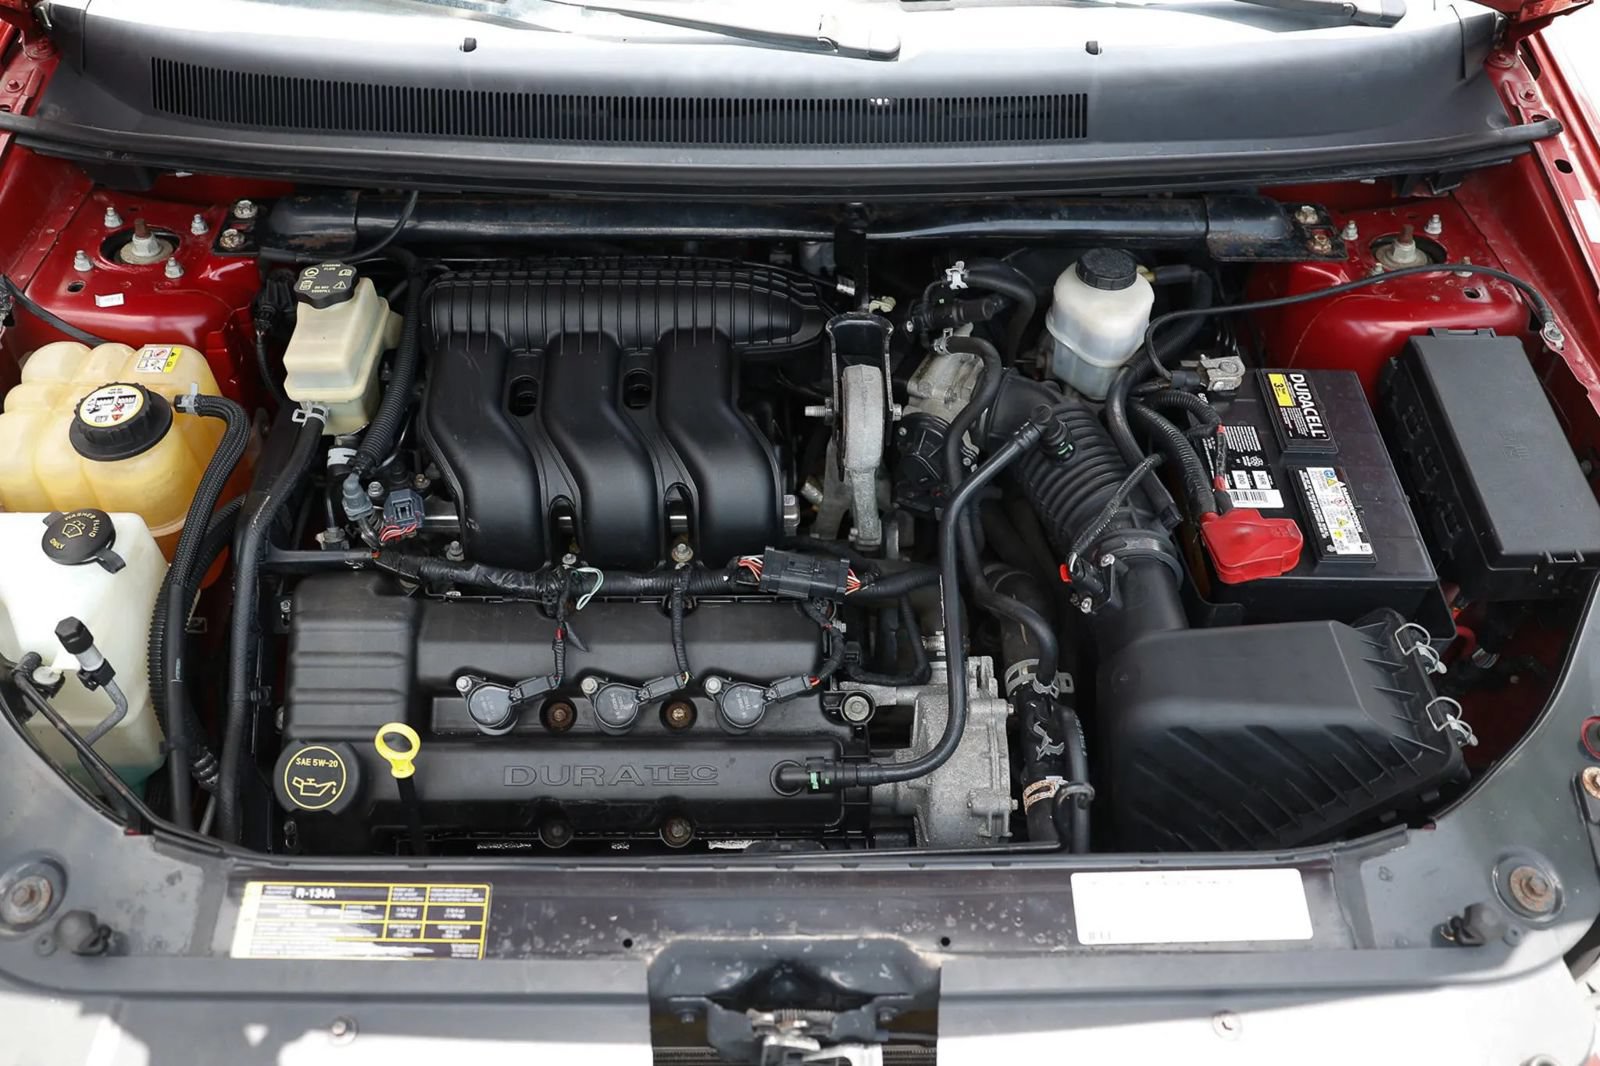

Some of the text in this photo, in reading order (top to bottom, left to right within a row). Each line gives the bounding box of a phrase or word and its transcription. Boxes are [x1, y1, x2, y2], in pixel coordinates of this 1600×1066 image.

[1289, 373, 1328, 438] DURACELL
[64, 512, 97, 520] WASHER
[49, 538, 65, 549] ONLY
[295, 757, 339, 768] SAE 5W-20
[503, 764, 719, 787] DURATEC
[295, 886, 337, 899] R-134A
